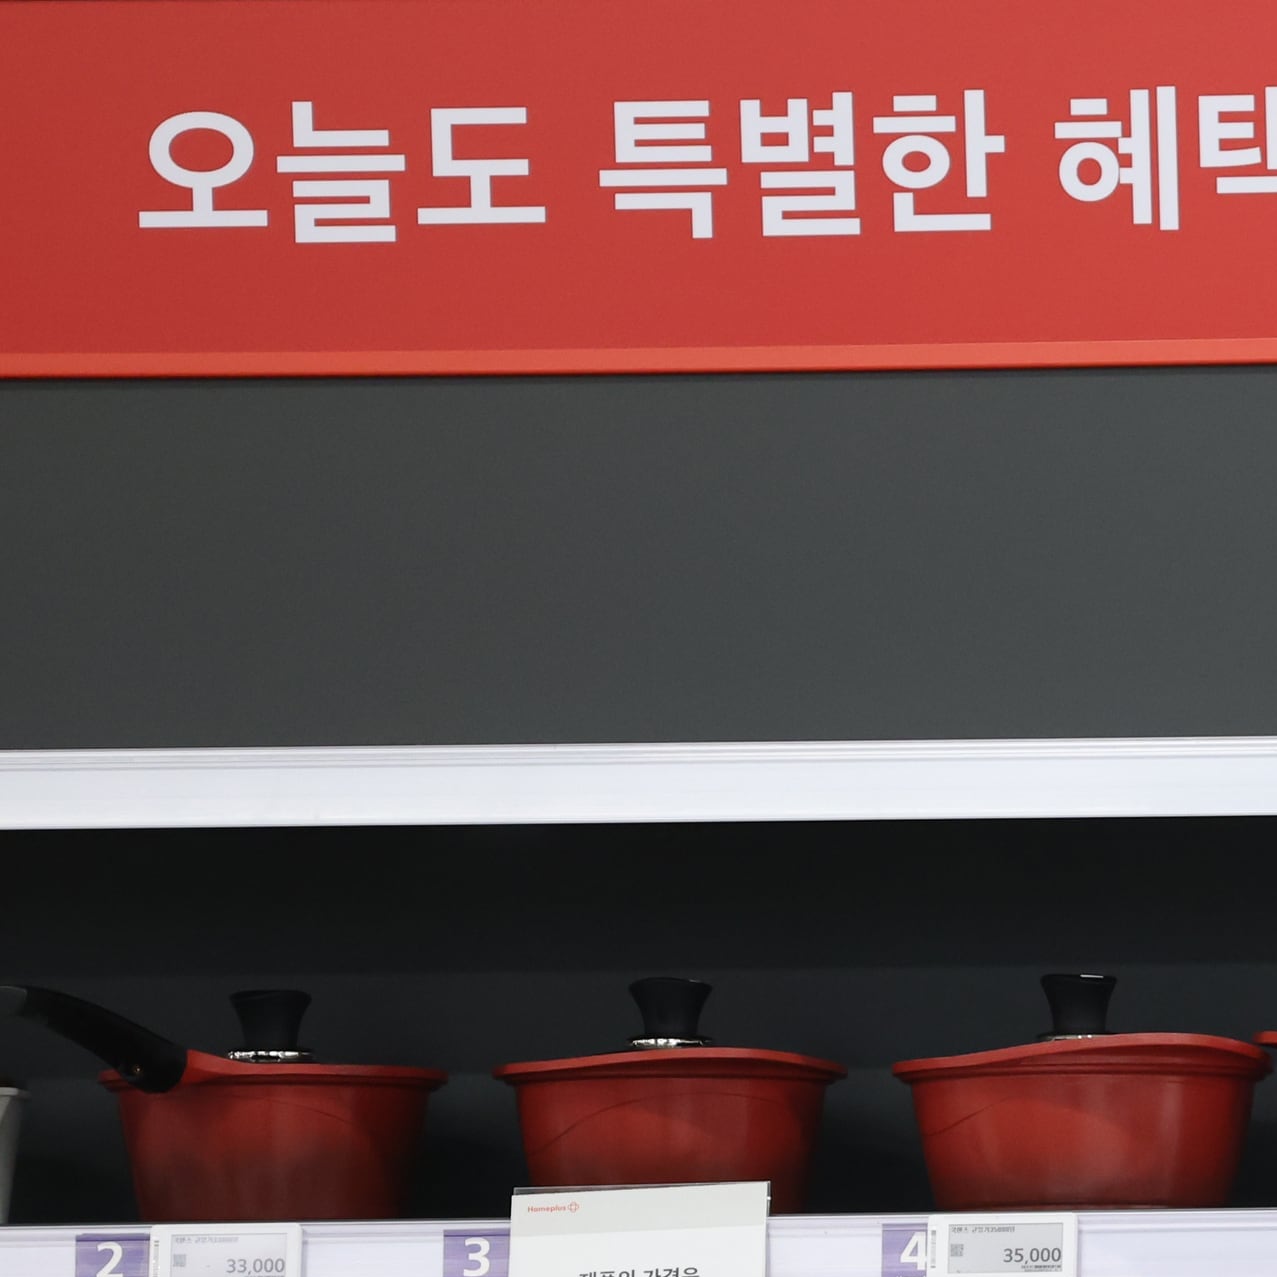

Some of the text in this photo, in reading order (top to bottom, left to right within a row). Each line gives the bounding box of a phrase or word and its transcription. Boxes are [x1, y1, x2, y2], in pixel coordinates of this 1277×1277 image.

[139, 101, 545, 243] 오늘도
[599, 89, 1004, 239] 특별한
[528, 1203, 566, 1213] Homeplus
[463, 1237, 490, 1277] 3
[900, 1231, 926, 1270] 4
[1003, 1248, 1061, 1264] 35,000
[226, 1258, 285, 1275] 33,000
